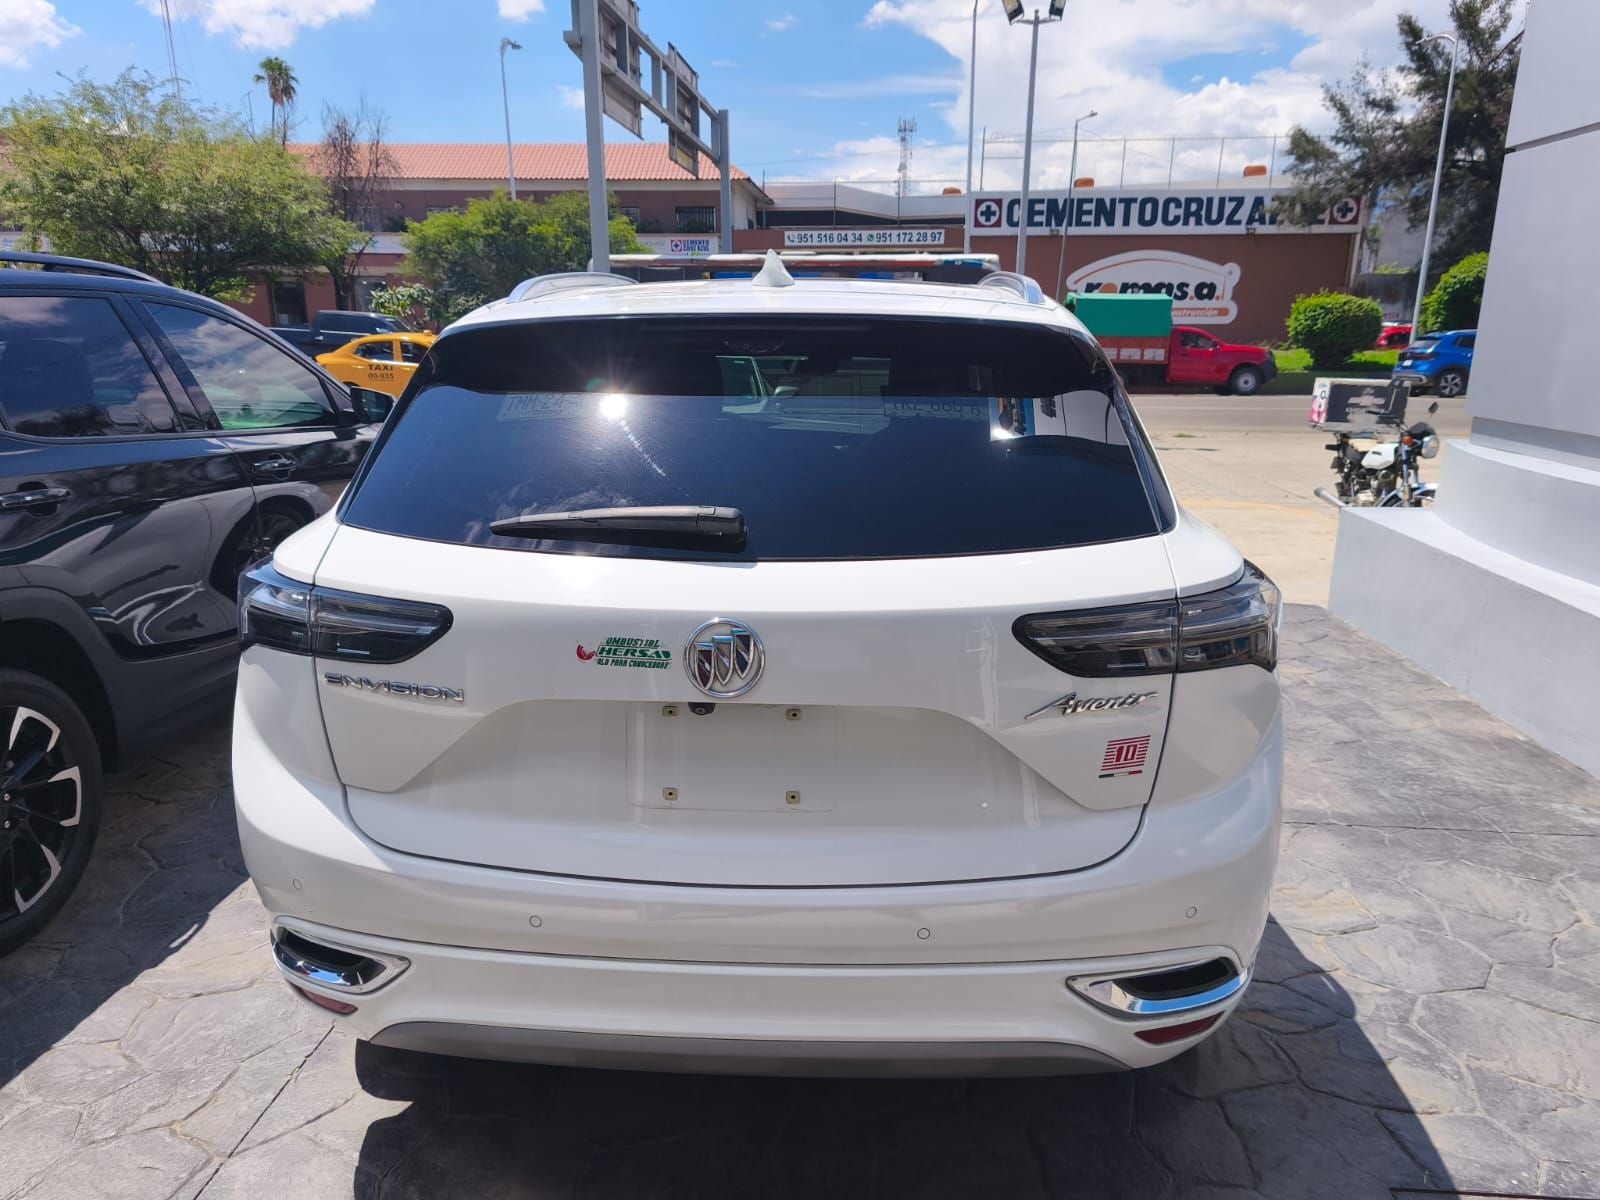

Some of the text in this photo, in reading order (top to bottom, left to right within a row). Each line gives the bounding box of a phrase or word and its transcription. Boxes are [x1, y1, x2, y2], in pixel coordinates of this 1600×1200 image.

[1006, 196, 1325, 227] CEMENTOCRUZA
[797, 231, 942, 243] 951 516 04 34 951 172 28 97
[325, 672, 464, 702] ENVISION
[1024, 691, 1159, 719] Avenir
[1115, 744, 1138, 762] 10
